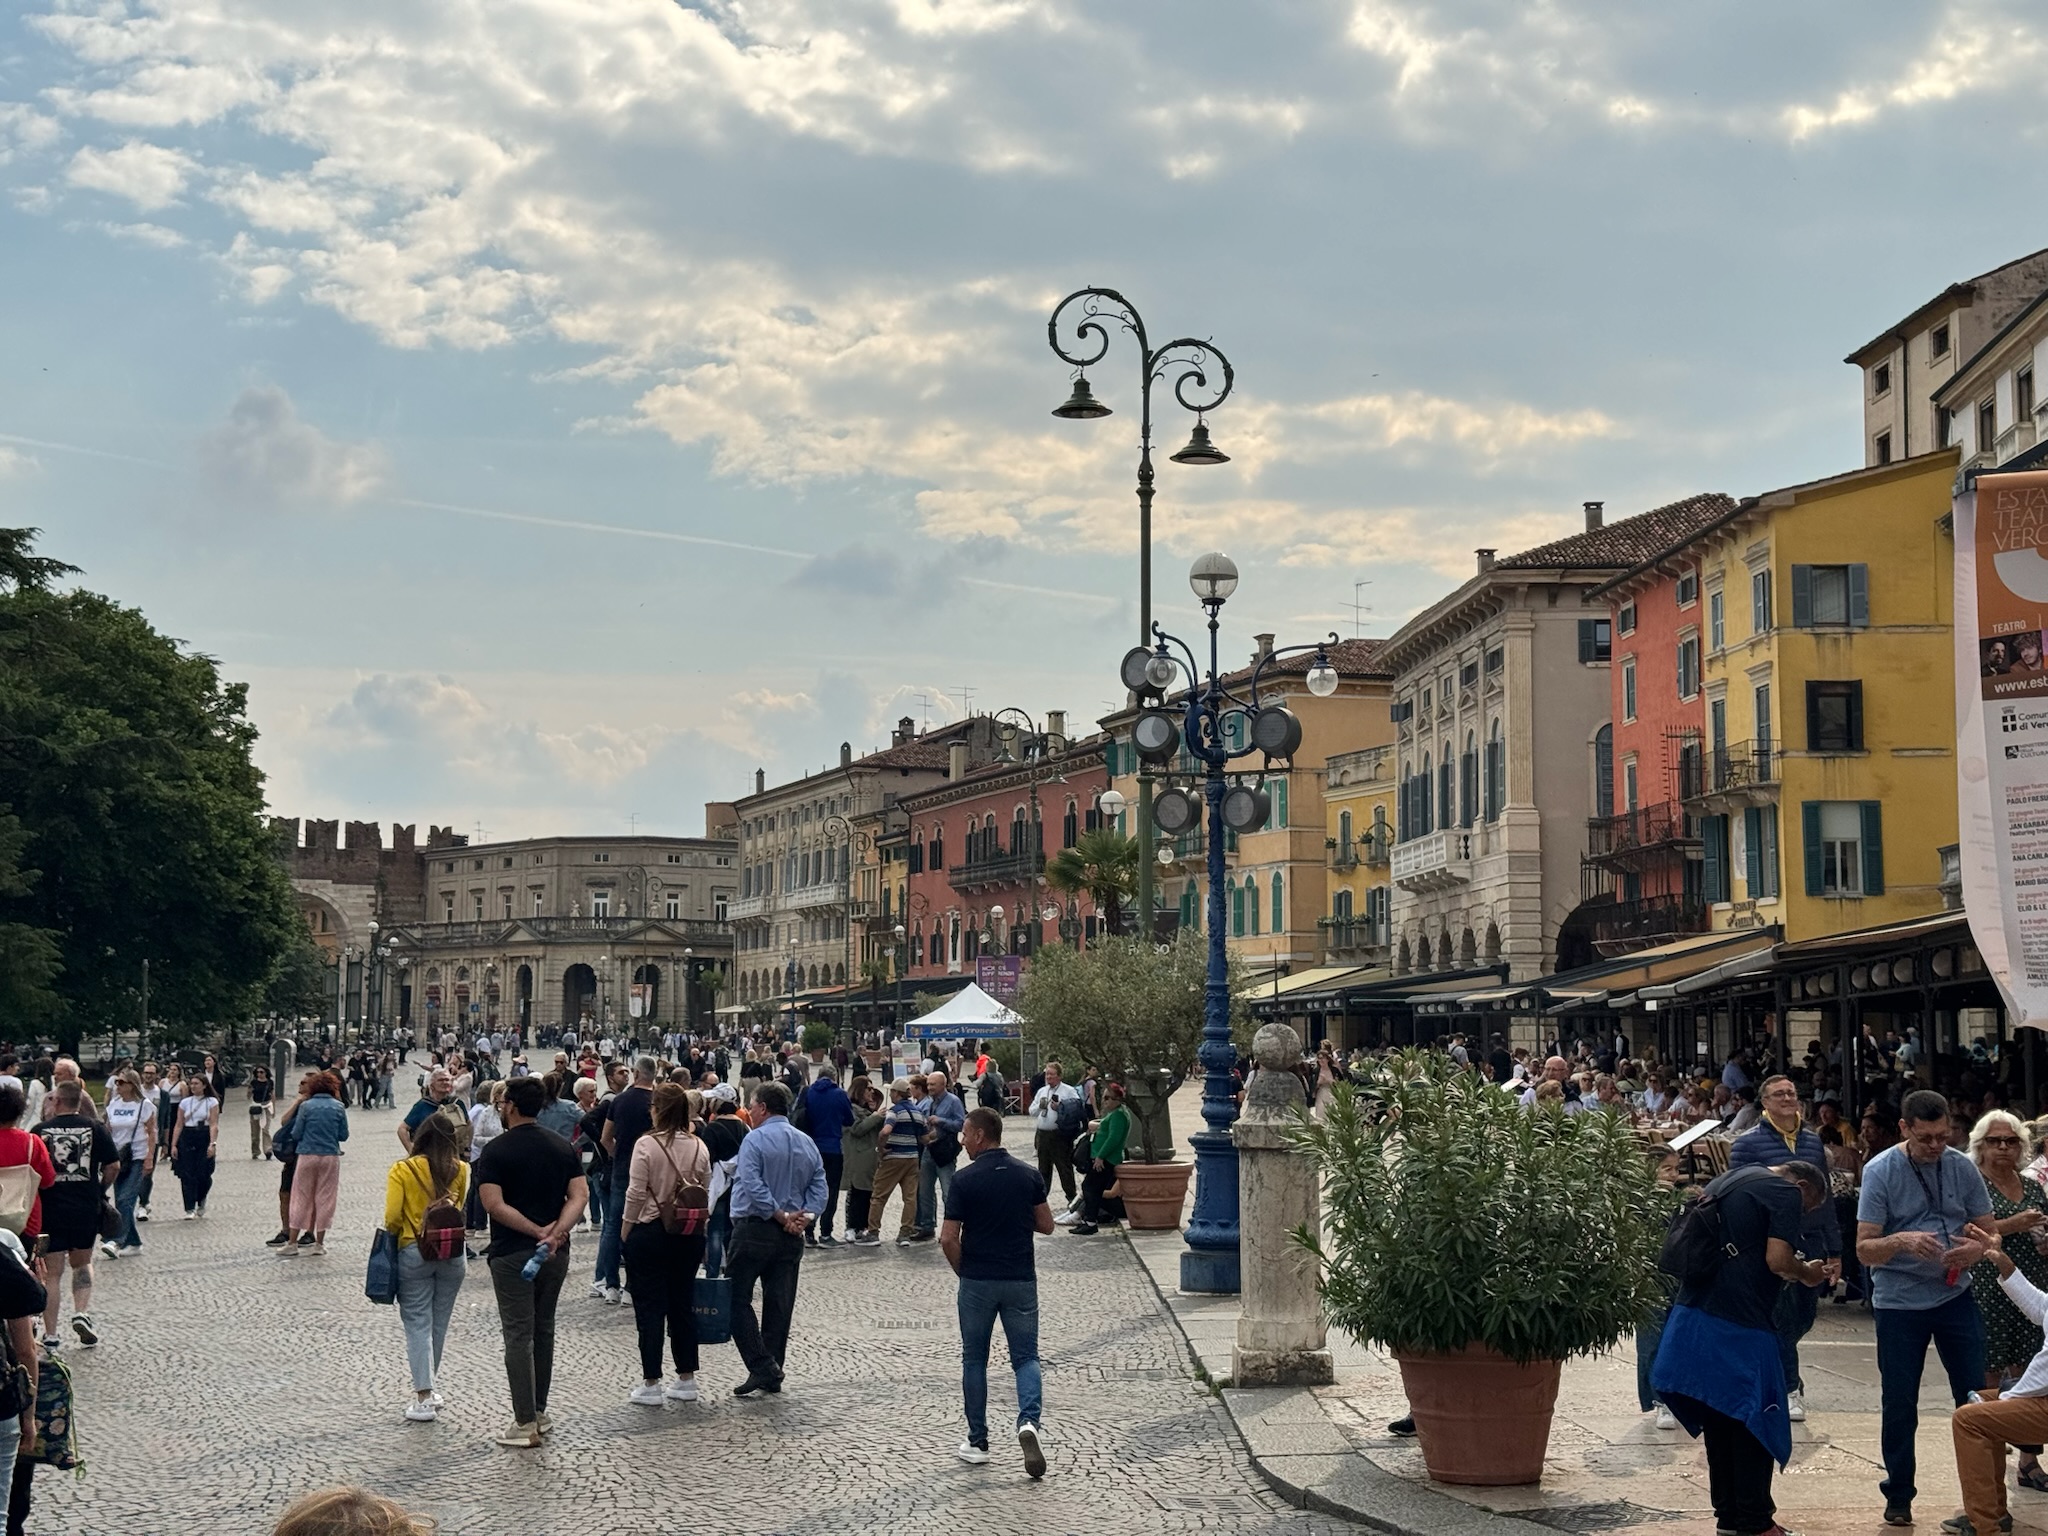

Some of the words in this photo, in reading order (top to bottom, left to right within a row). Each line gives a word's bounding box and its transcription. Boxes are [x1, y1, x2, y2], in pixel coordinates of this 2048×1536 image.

[1997, 488, 2048, 509] ESTA
[1993, 505, 2048, 530] TEAT
[1992, 620, 2027, 634] TEATRO
[2019, 722, 2028, 731] di
[2006, 796, 2027, 805] PAOLO
[2009, 822, 2023, 830] JAN
[2015, 879, 2037, 887] MARIO
[2017, 904, 2032, 912] ELIO
[113, 1109, 135, 1117] ESCAPE
